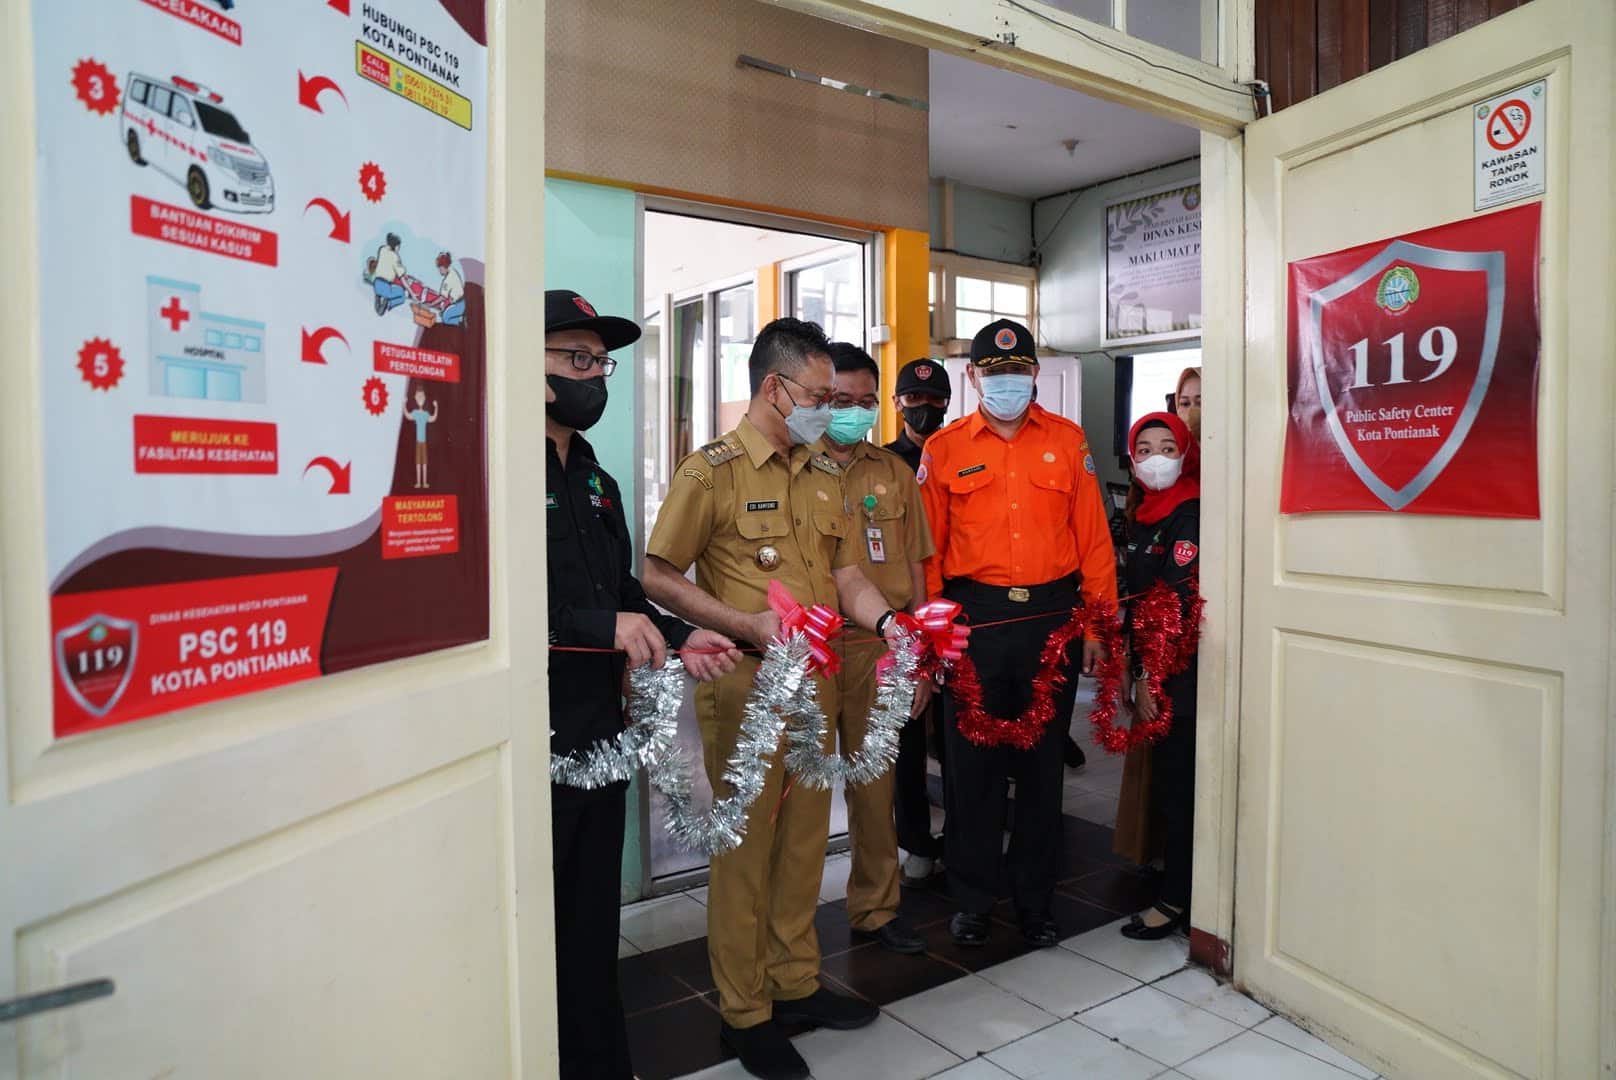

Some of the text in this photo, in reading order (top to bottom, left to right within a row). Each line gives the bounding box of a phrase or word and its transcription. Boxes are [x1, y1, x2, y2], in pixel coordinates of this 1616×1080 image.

[362, 3, 459, 69] HUBUNGI PSC 119
[363, 24, 460, 88] KOTA PONTIANAK
[88, 75, 104, 100] 3
[1482, 146, 1537, 169] KAWASAN
[1491, 160, 1527, 177] TANPA
[368, 175, 377, 192] 4
[1489, 171, 1529, 189] ROKOK
[150, 205, 262, 244] BANTUAN DIKIRIM
[161, 225, 253, 257] SESUAI KASUS
[1143, 228, 1175, 242] DINAS
[1129, 245, 1190, 265] MAKLUMAT
[184, 347, 226, 360] HOSPITAL
[381, 345, 453, 367] PETUGAS TERLATIH
[1347, 325, 1458, 389] 119
[94, 353, 109, 377] 5
[390, 360, 445, 377] PERTOLONGAN
[371, 388, 380, 406] 6
[1346, 404, 1454, 423] Public Safety Center
[170, 430, 249, 446] MERUJUK KE
[1357, 424, 1440, 441] Kota Pontianak
[139, 446, 275, 462] FASILITAS KESEHATAN
[398, 511, 443, 524] TERTOLONG
[1177, 548, 1193, 557] 119
[149, 594, 308, 625] DINAS KESEHATAN KOTA PONTIANAK
[179, 619, 288, 663] PSC 119
[78, 645, 124, 674] 119
[151, 667, 207, 696] KOTA
[211, 646, 312, 683] PONTIANAK
